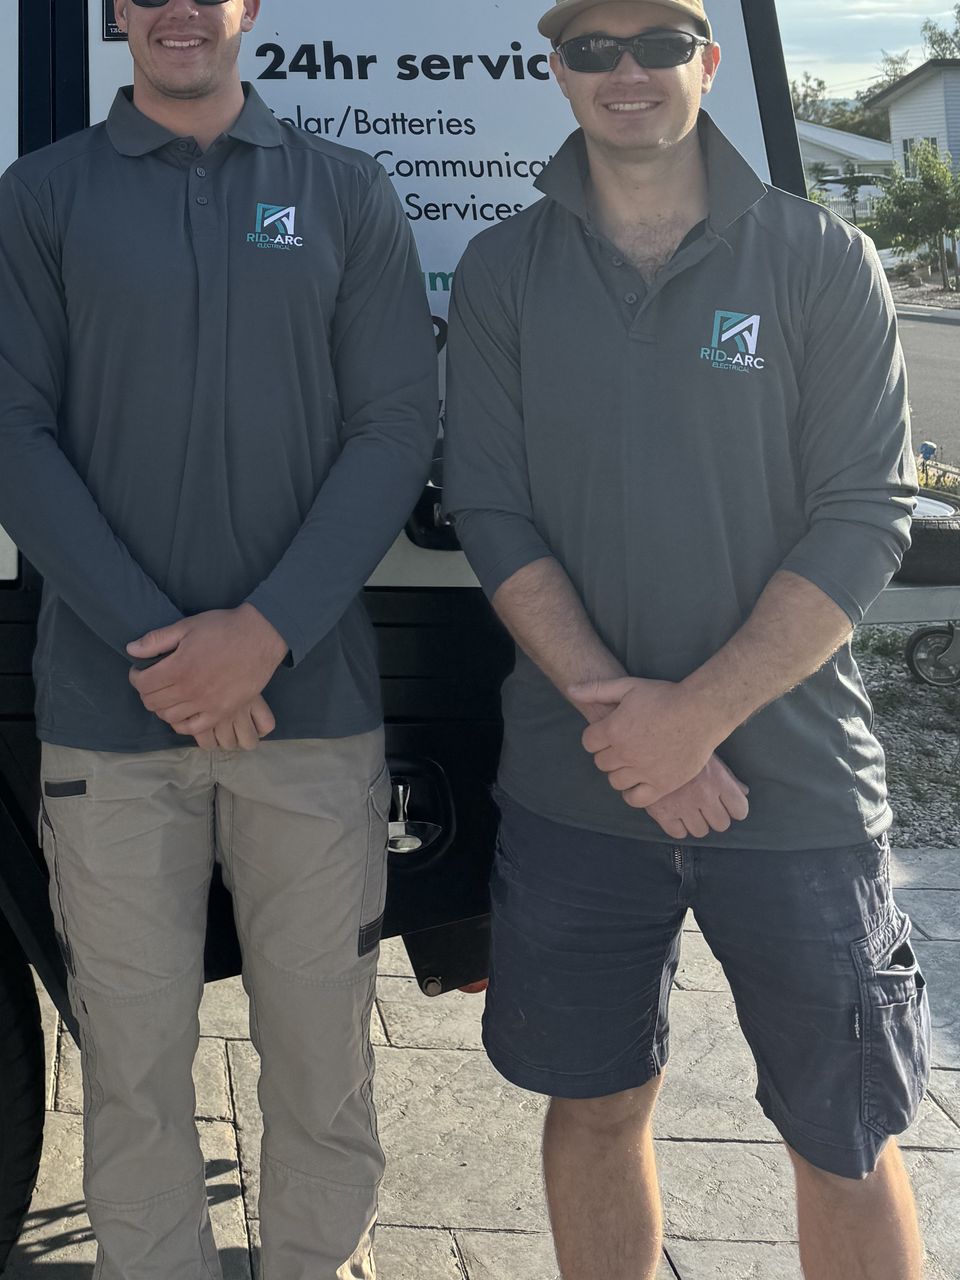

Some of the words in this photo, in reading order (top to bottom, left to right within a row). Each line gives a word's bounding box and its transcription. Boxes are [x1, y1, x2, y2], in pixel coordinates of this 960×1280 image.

[255, 40, 378, 81] 24hr
[396, 41, 551, 81] servic
[269, 105, 477, 138] lar/Batteries
[373, 150, 554, 178] Communica
[246, 232, 304, 247] RID-ARC
[700, 347, 765, 370] RID-ARC
